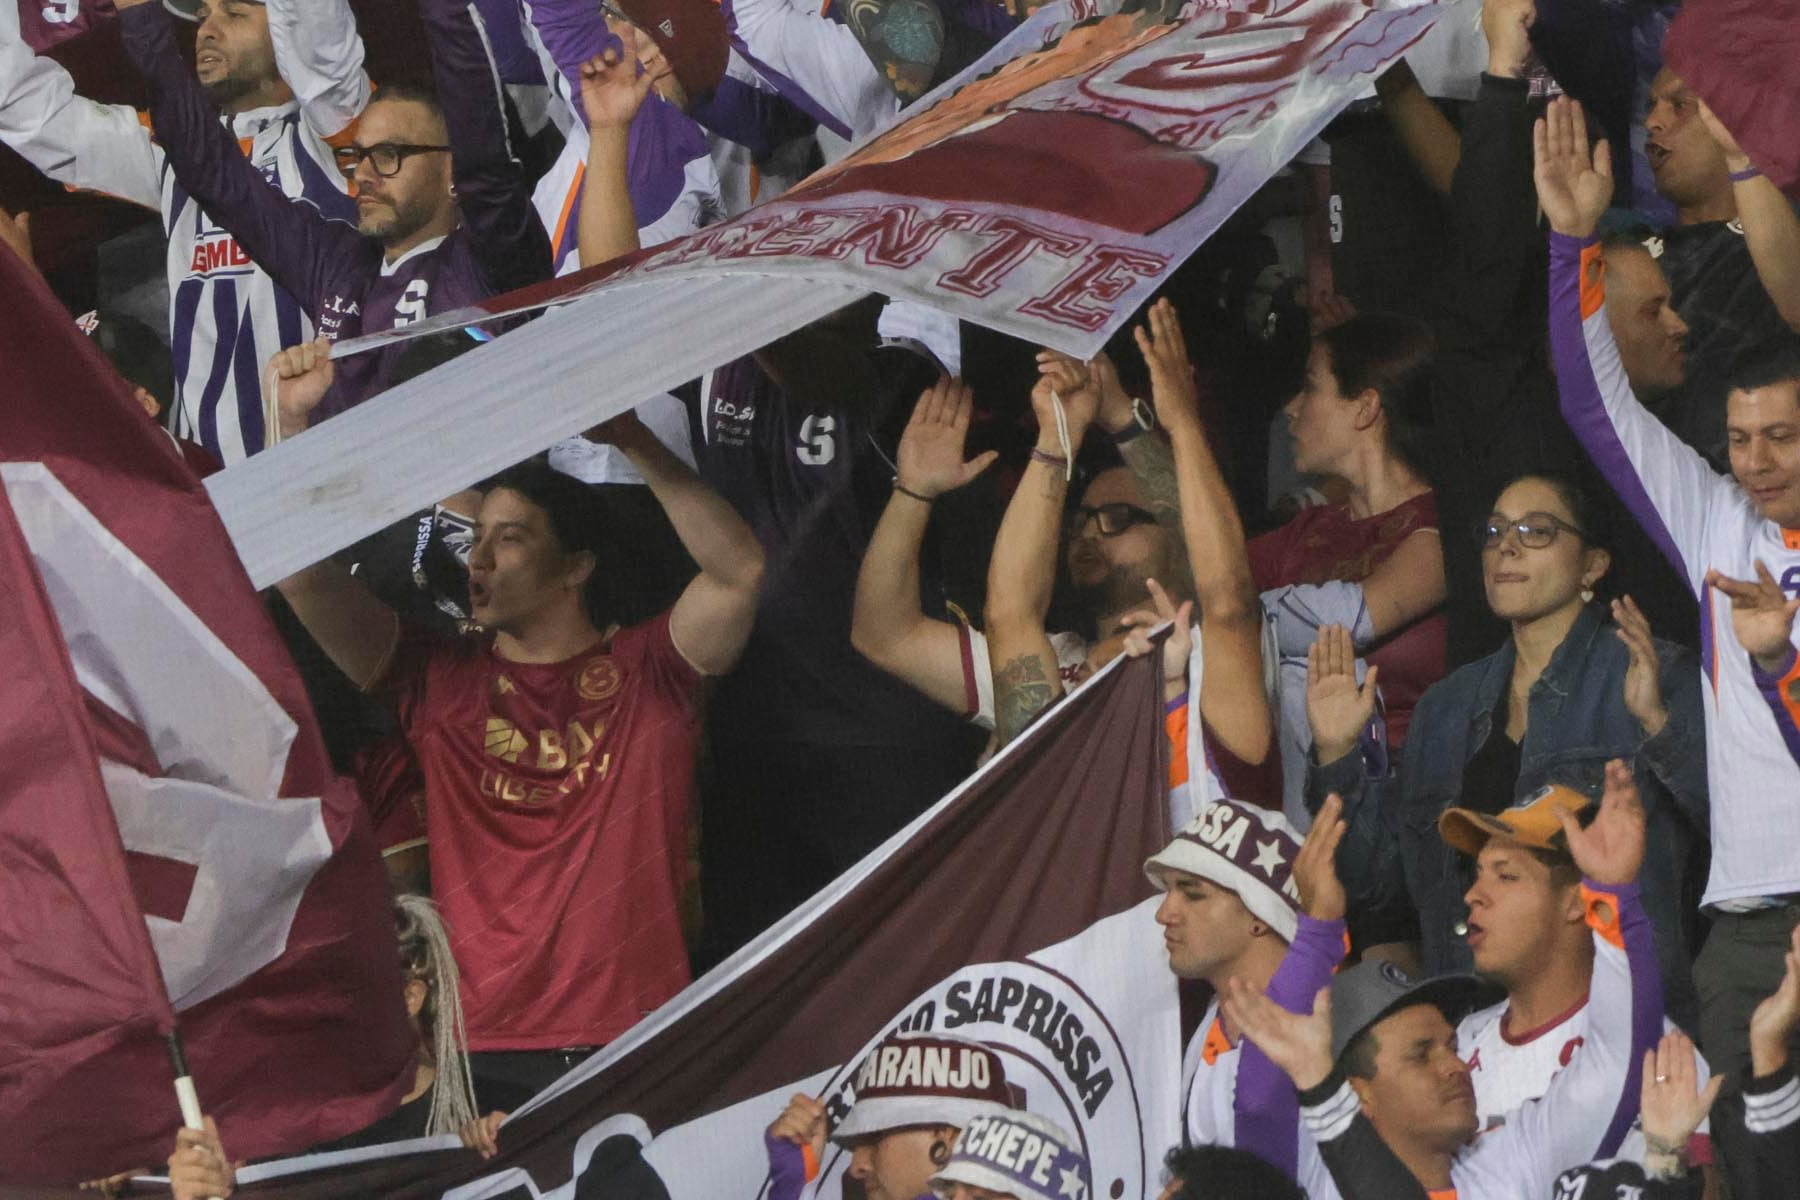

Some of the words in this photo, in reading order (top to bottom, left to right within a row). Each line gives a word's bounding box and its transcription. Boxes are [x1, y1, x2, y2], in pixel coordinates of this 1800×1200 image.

[394, 279, 428, 329] S
[795, 413, 835, 465] S
[858, 1045, 990, 1091] ARANJO
[944, 975, 1114, 1120] SAPRISSA
[963, 1115, 1060, 1188] CHEPE
